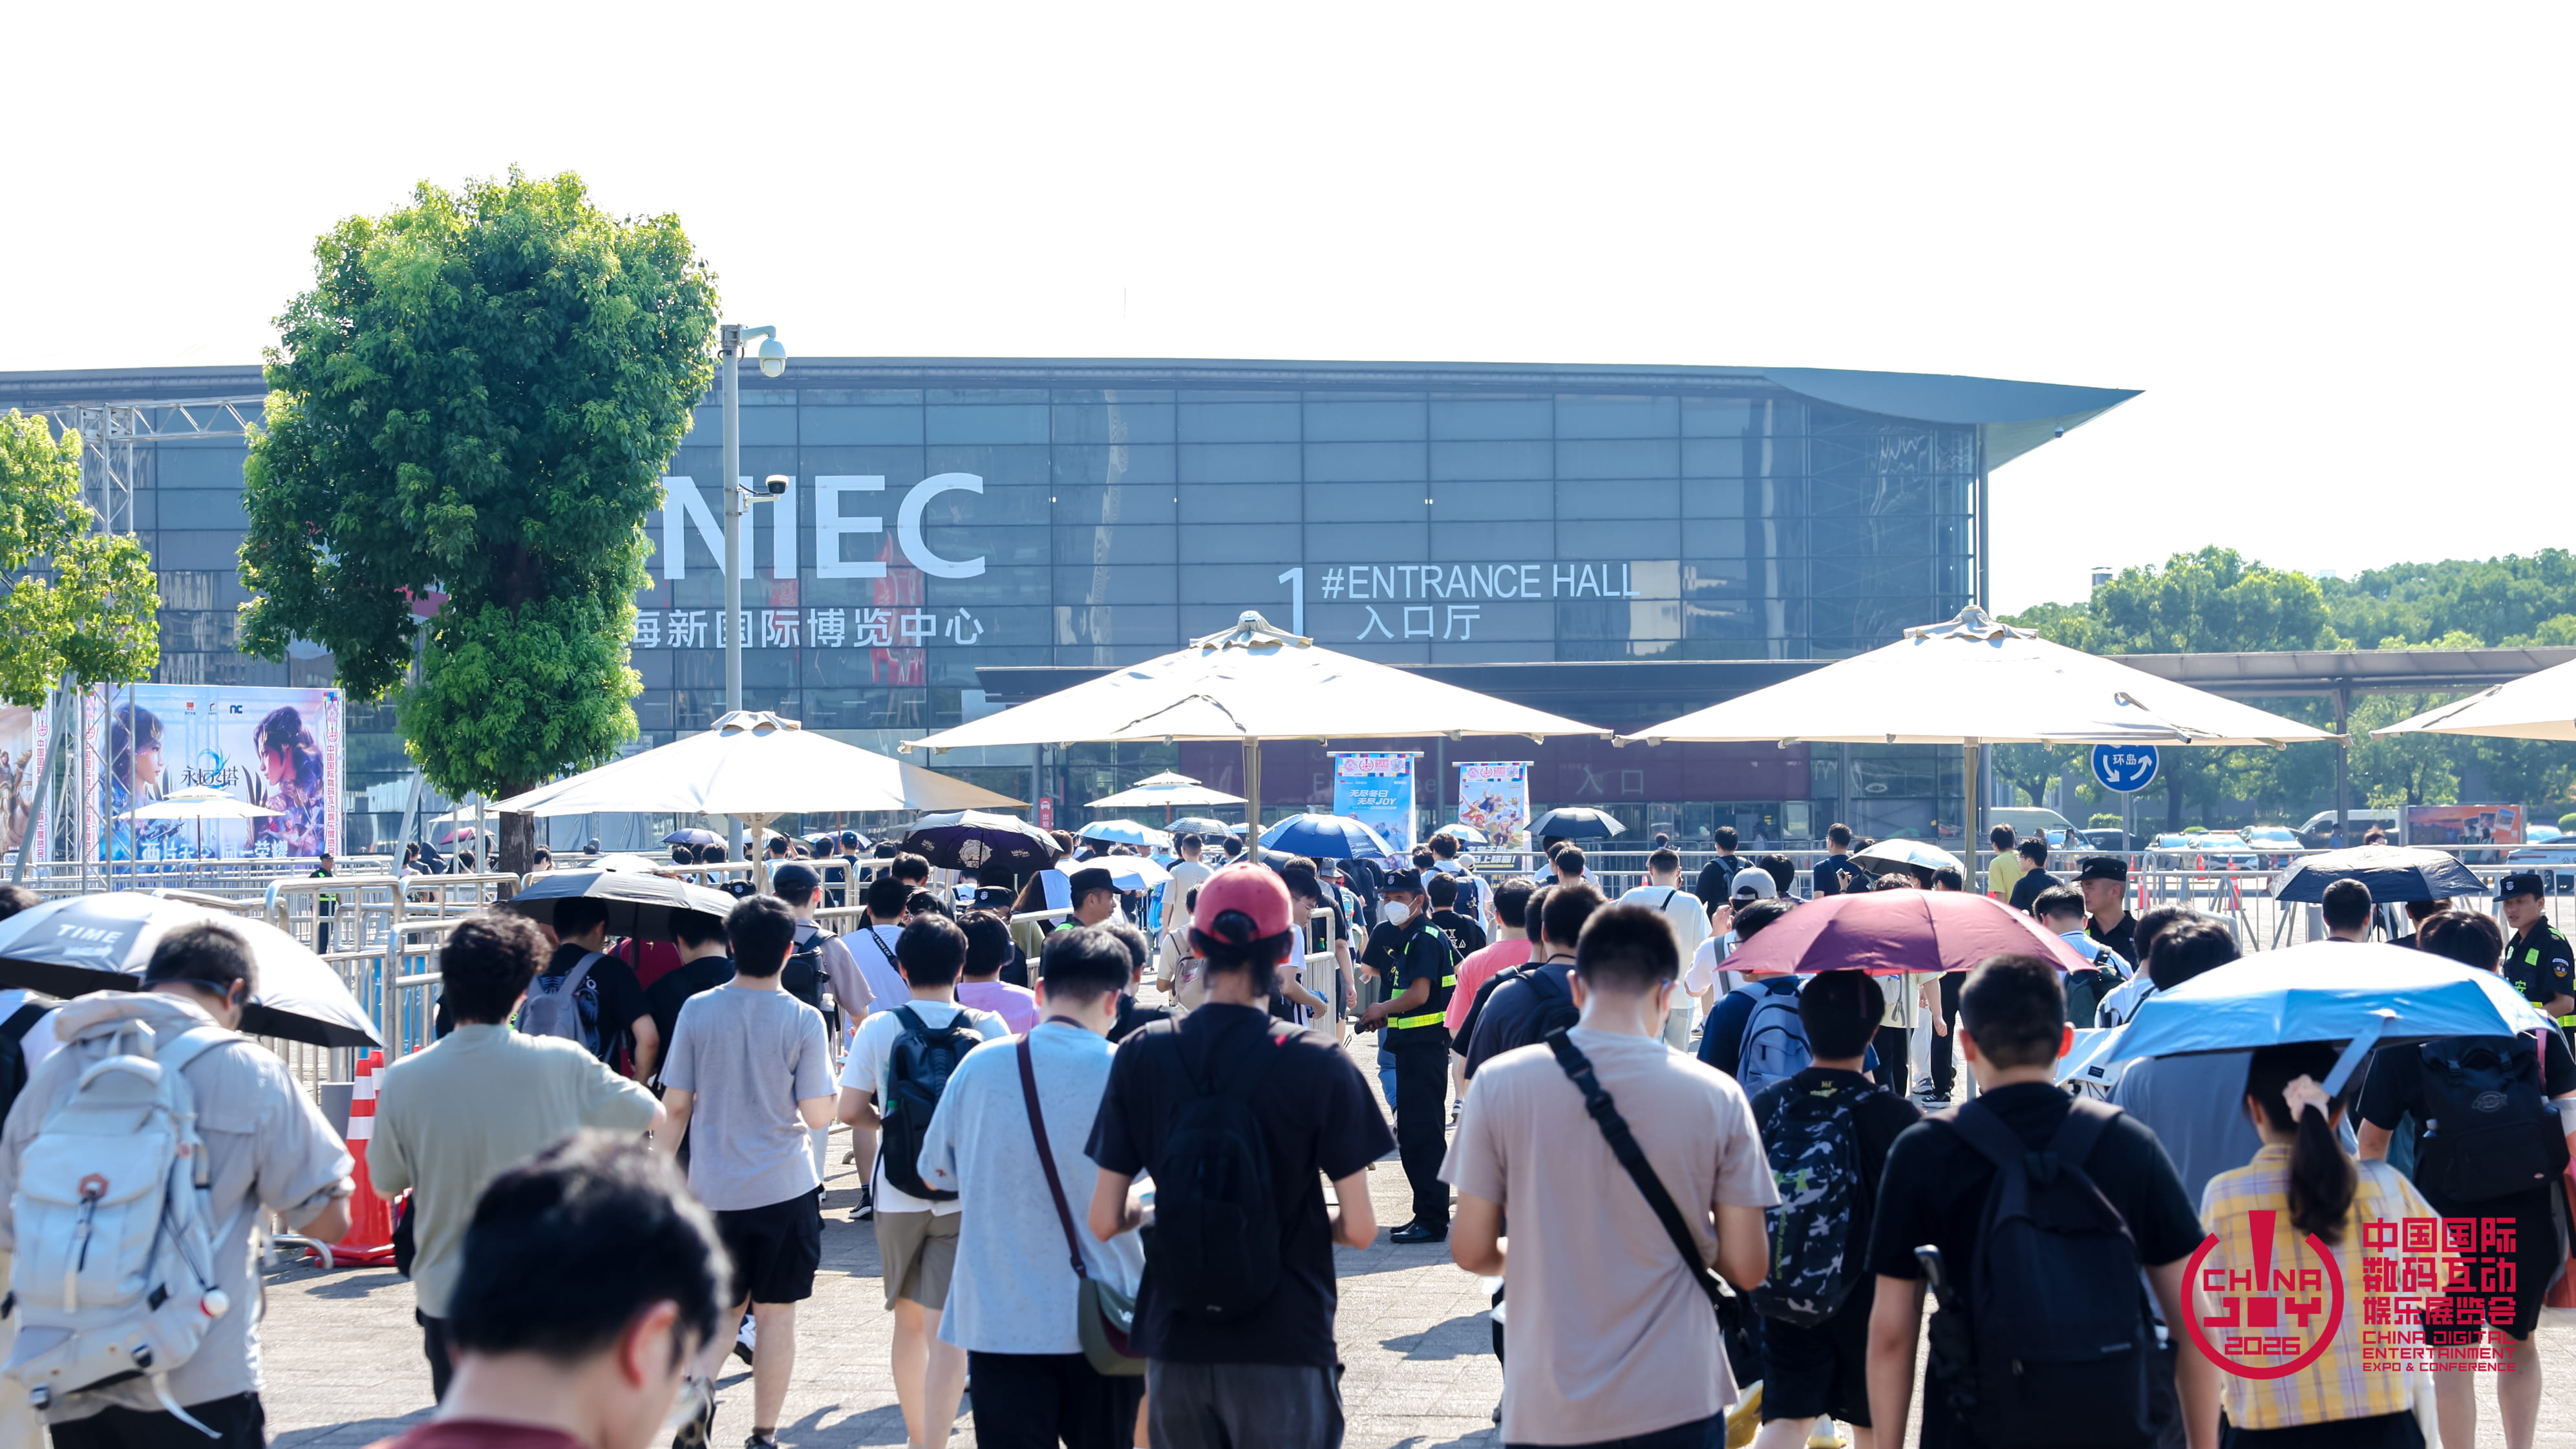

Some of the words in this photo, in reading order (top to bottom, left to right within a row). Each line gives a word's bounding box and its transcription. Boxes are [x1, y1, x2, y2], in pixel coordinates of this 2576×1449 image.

[1278, 567, 1304, 635] 1
[1322, 565, 1541, 599] #ENTRANCE
[1553, 563, 1640, 597] HALL
[1356, 605, 1480, 640] 入口厅
[2113, 754, 2136, 765] 环岛
[180, 765, 239, 787] 永恒之塔
[1576, 766, 1644, 795] 入口
[57, 924, 124, 944] TIME
